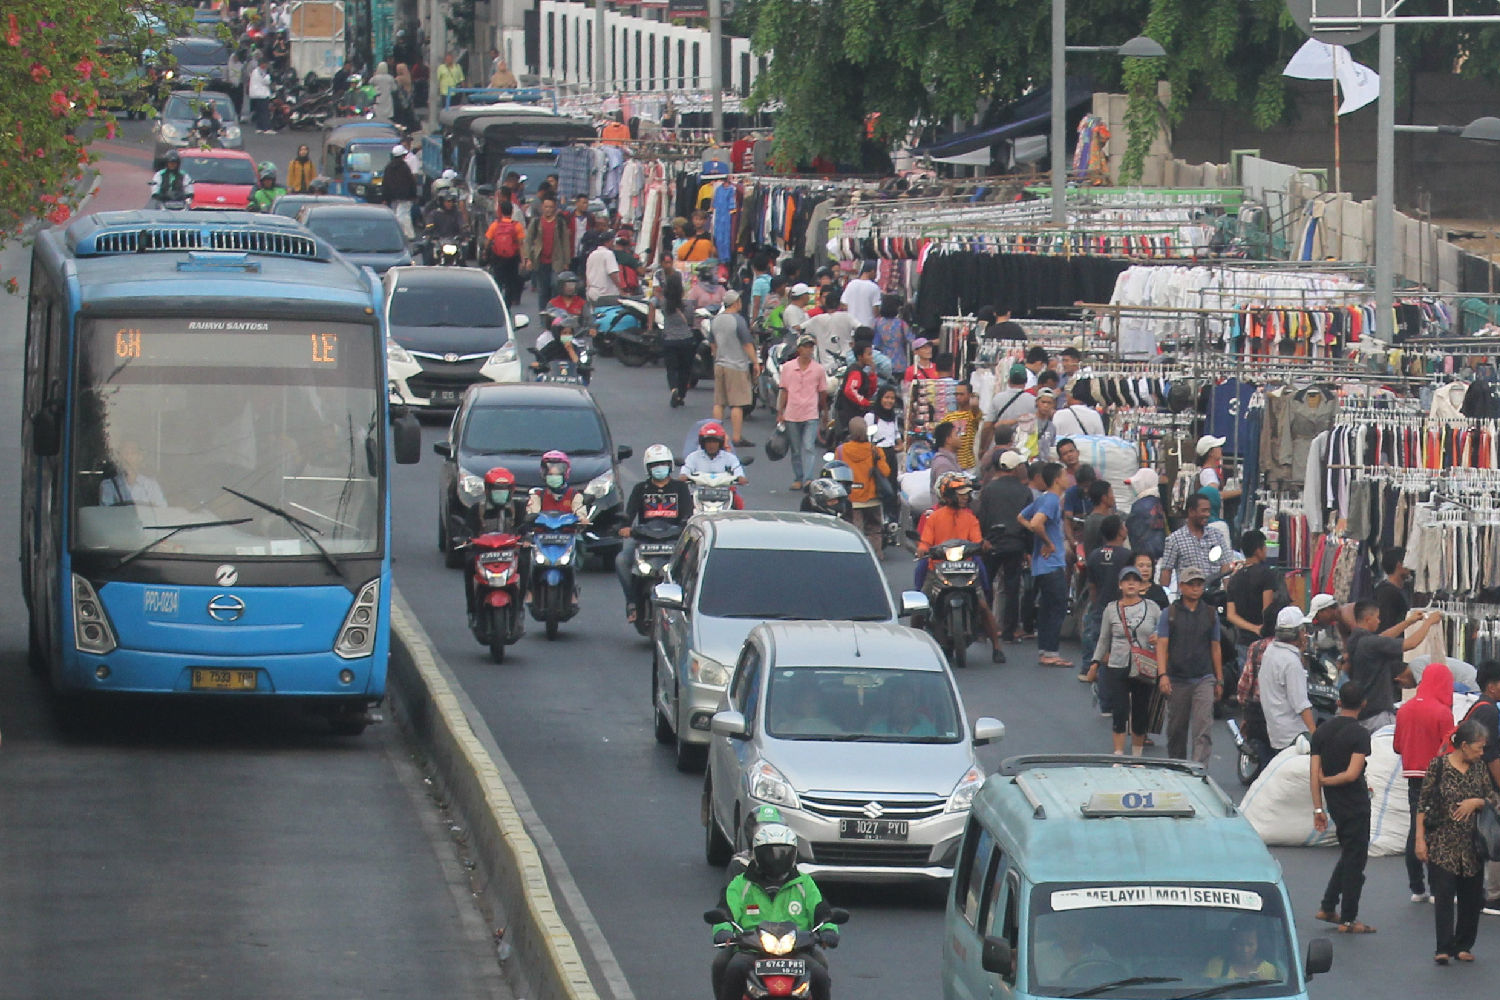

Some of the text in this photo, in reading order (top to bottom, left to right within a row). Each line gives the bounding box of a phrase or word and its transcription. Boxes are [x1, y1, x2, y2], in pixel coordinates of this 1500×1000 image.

[188, 321, 269, 331] RAHAYU SANTOSA
[115, 328, 141, 358] 6H
[1122, 792, 1154, 809] 01
[841, 820, 907, 835] B 1027 PYU
[1194, 890, 1240, 905] SENEN
